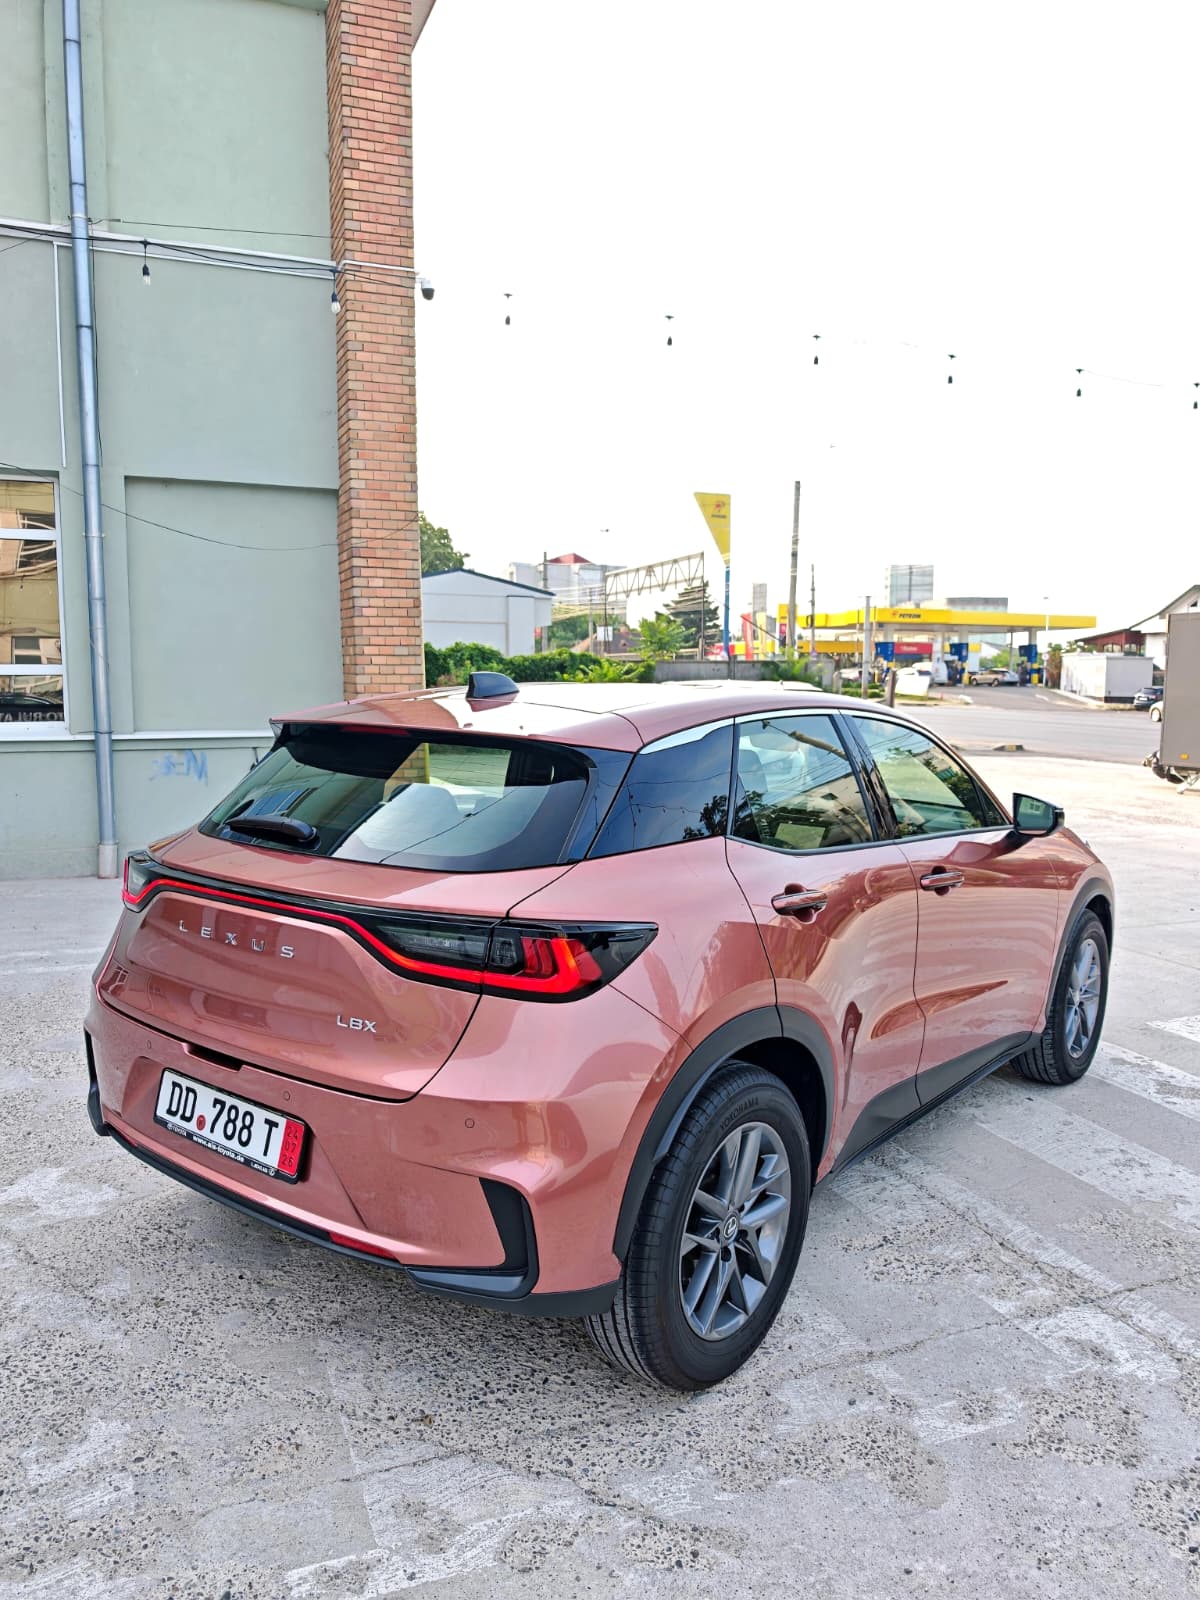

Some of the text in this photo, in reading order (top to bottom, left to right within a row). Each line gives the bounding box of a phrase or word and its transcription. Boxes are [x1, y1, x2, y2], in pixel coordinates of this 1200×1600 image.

[178, 919, 295, 958] LEXUS
[336, 1014, 377, 1033] LBX
[166, 1081, 279, 1157] DD 788 T
[720, 1096, 759, 1129] YOKOHAMA
[287, 1126, 298, 1140] 24
[285, 1140, 297, 1153] 07
[282, 1154, 294, 1168] 26
